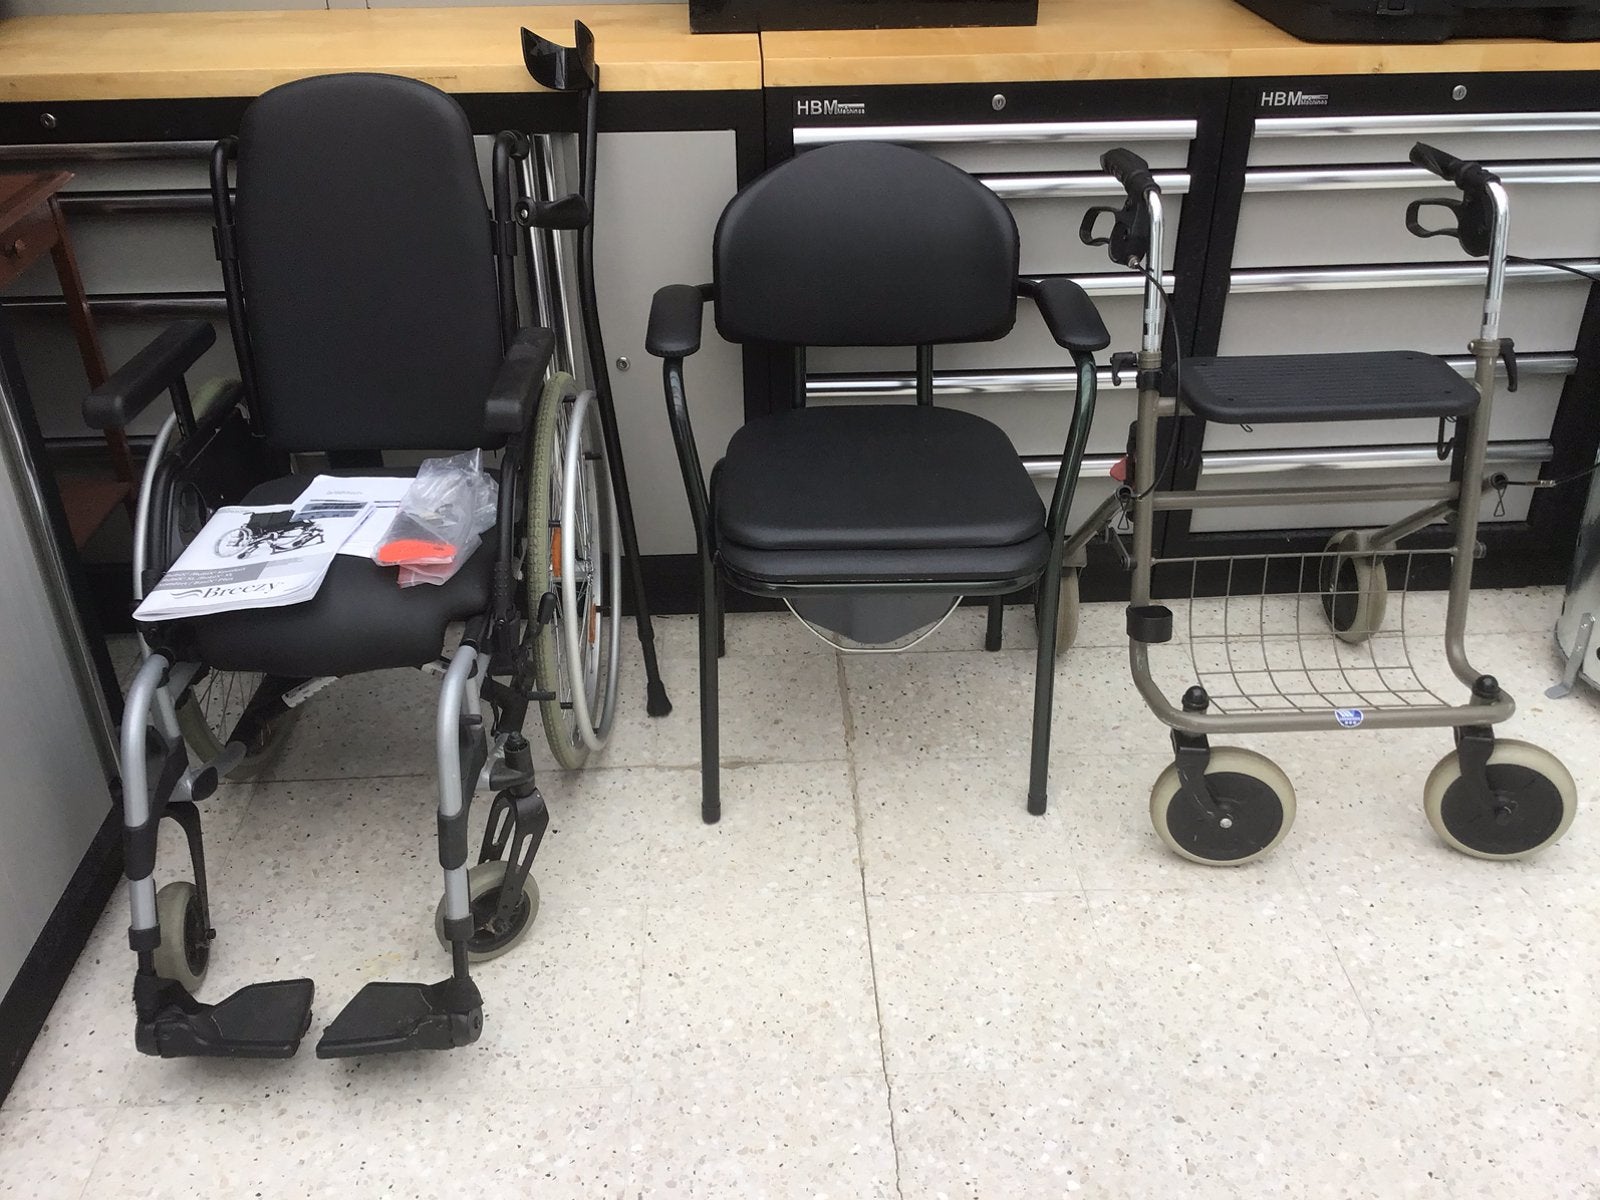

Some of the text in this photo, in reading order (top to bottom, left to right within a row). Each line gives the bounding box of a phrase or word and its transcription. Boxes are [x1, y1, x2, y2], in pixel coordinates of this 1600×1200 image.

[1261, 91, 1302, 106] HBM
[797, 99, 838, 115] HBM
[202, 582, 279, 598] Breezy
